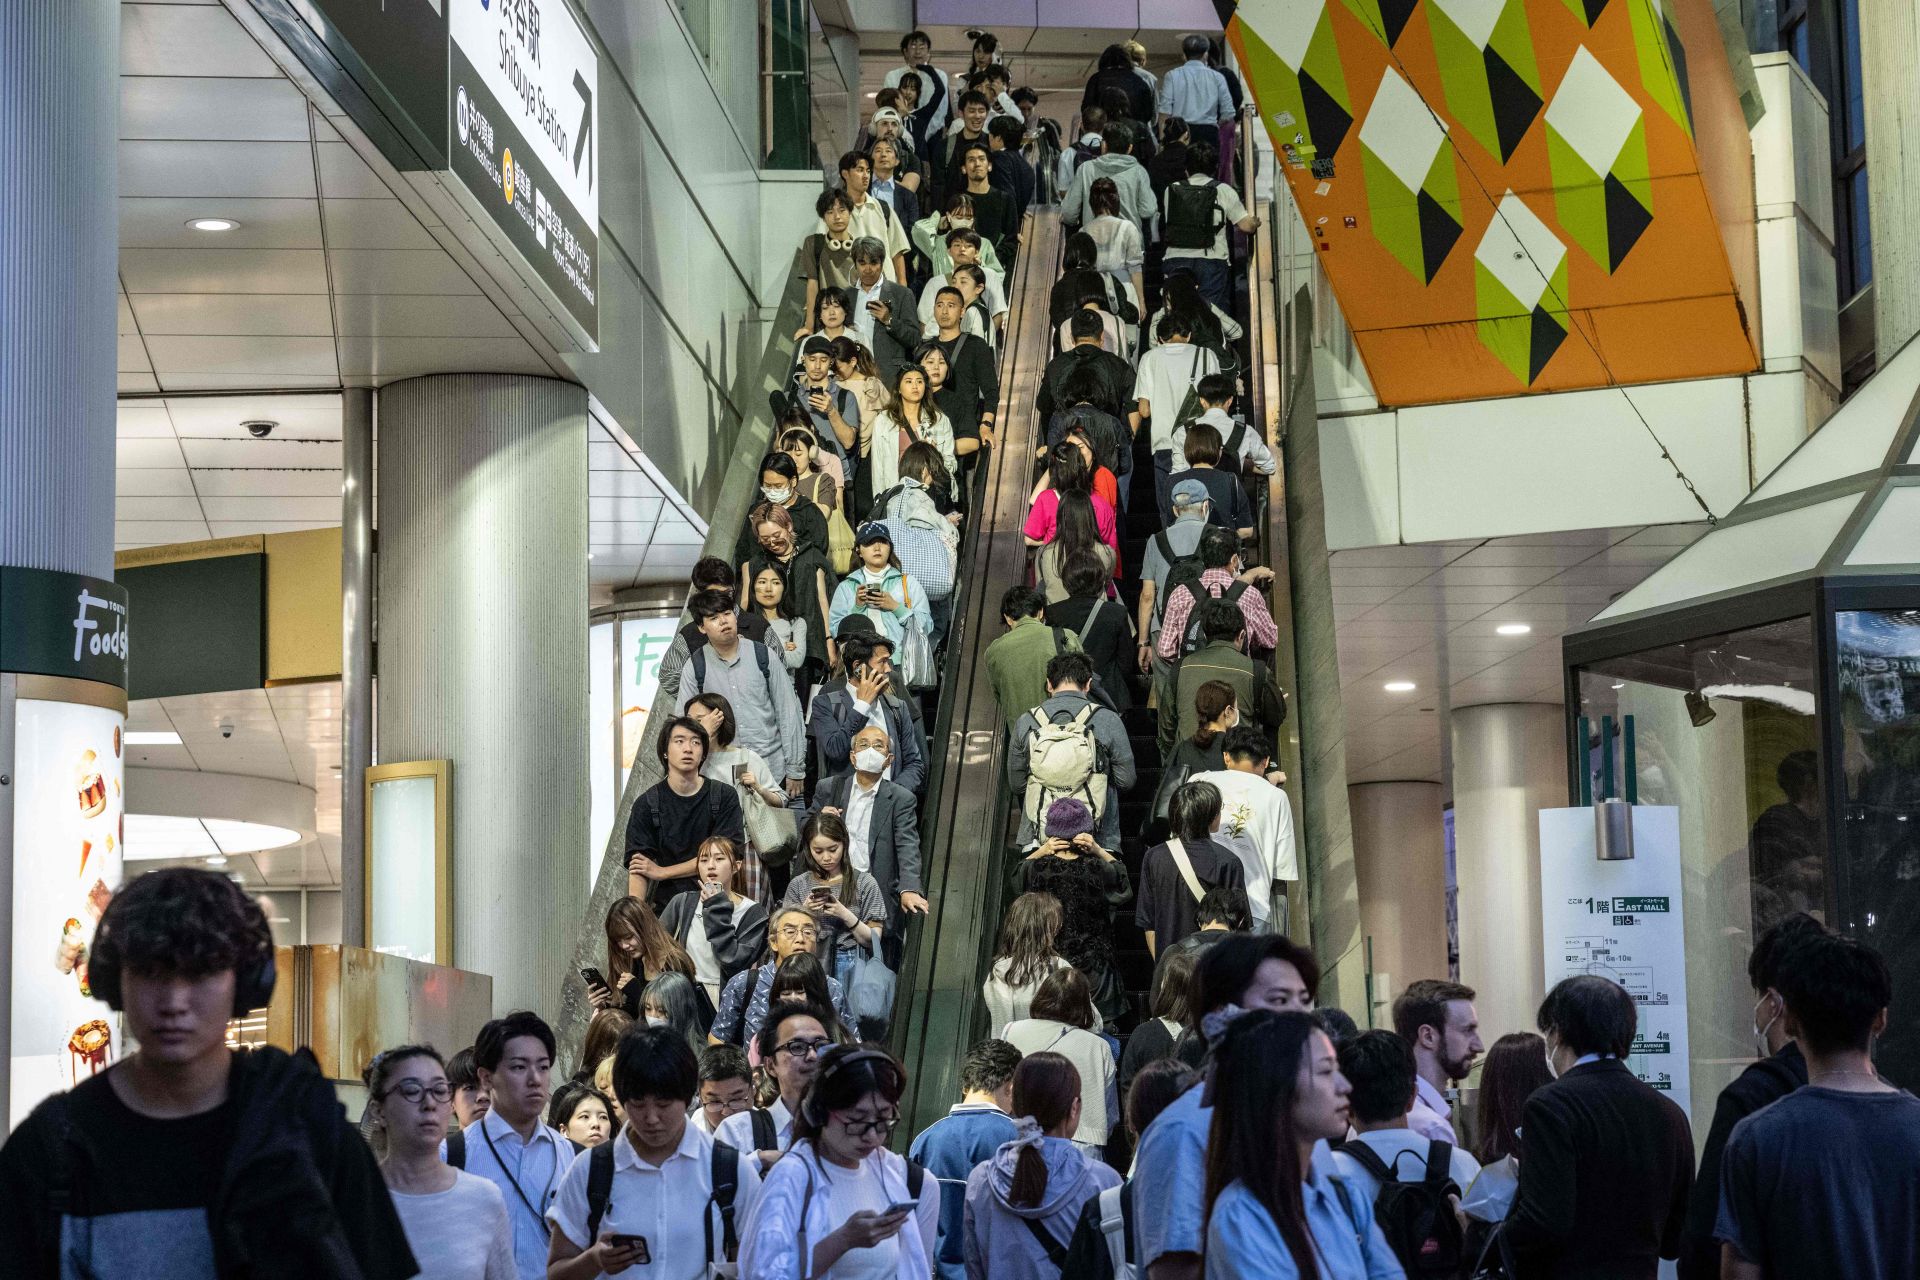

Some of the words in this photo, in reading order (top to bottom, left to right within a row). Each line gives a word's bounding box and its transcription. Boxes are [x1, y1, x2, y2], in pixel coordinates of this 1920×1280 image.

[500, 28, 536, 117] Shibuya
[537, 85, 568, 161] Station
[470, 99, 494, 154] 井の頭線
[492, 161, 501, 189] Line
[514, 160, 532, 204] 銀座線
[1614, 898, 1641, 911] EAST
